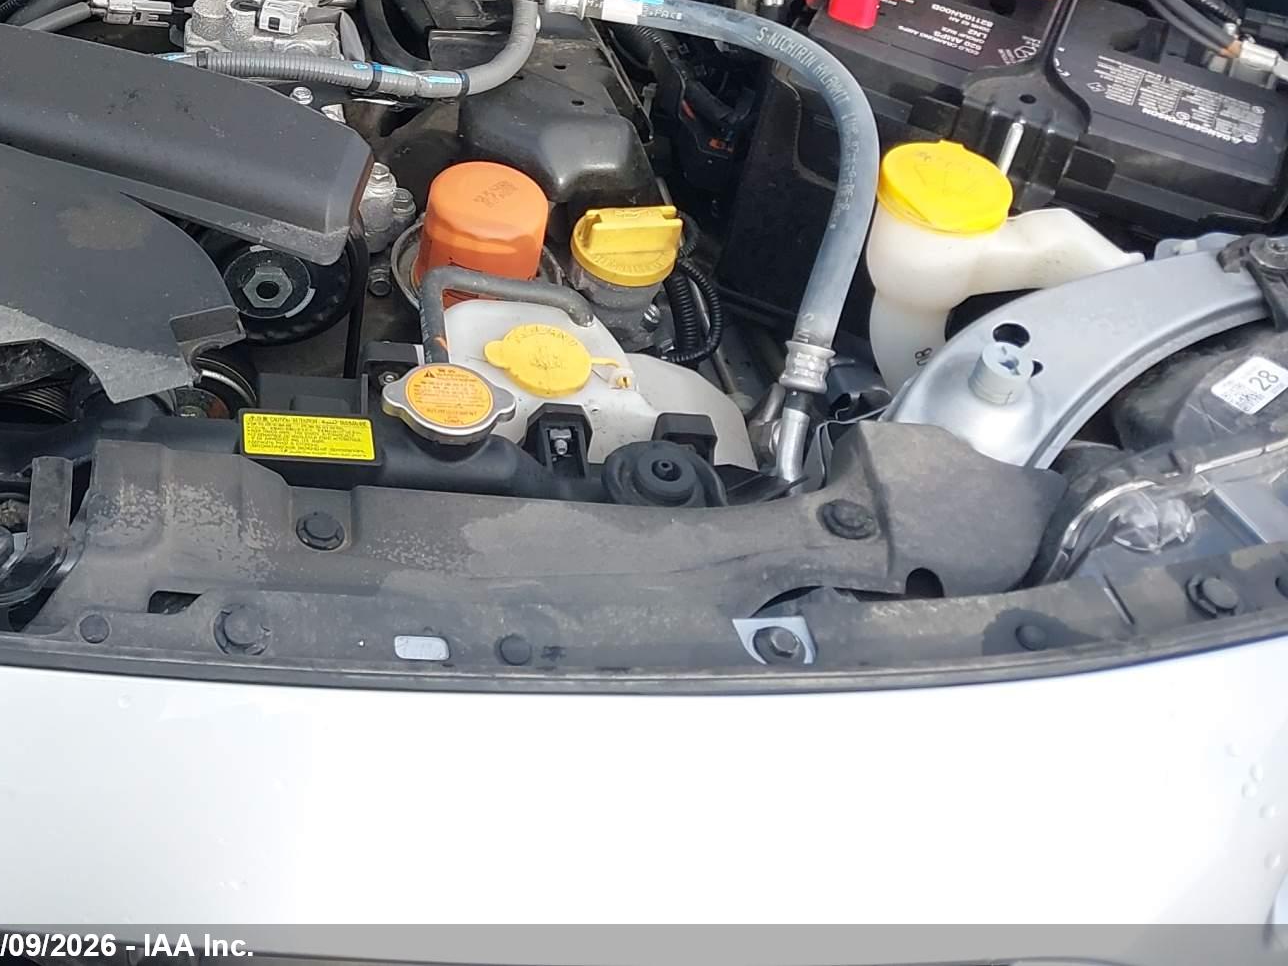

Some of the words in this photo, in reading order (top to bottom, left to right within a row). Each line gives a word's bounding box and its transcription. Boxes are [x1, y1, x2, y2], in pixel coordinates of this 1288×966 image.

[933, 31, 963, 44] AMPS
[958, 45, 980, 55] COLD
[1249, 370, 1279, 391] 28
